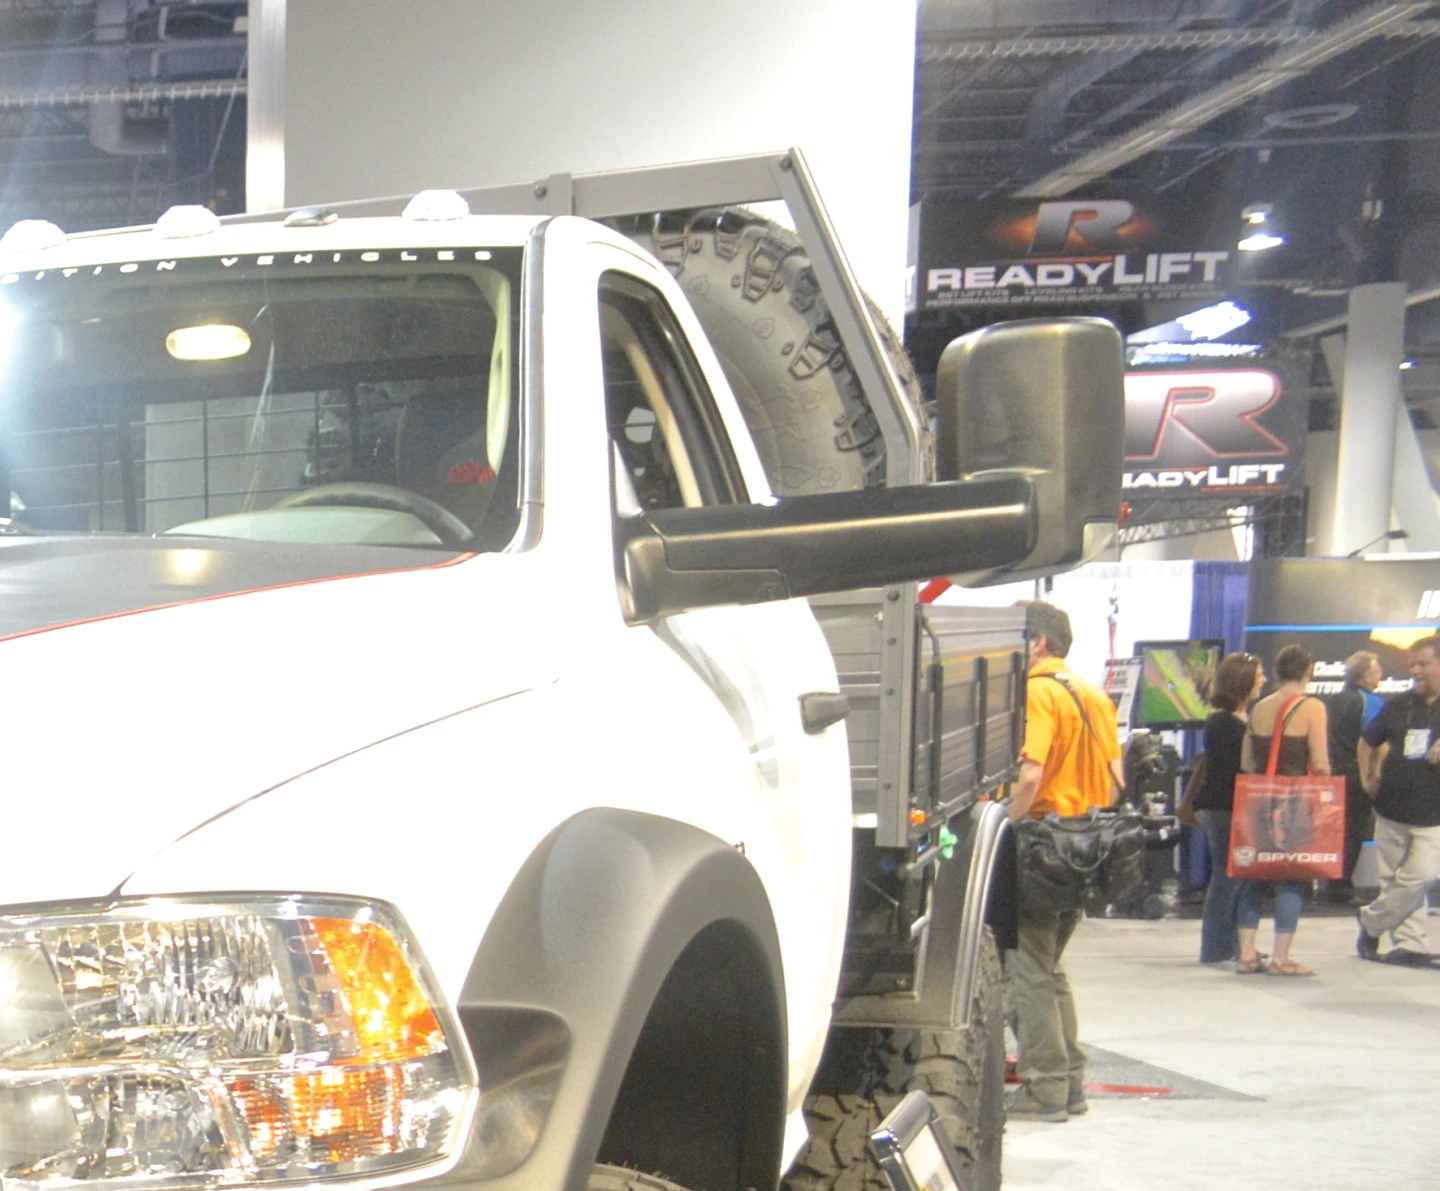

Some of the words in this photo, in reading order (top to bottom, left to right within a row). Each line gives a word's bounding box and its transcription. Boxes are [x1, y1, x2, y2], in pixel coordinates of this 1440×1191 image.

[221, 251, 492, 268] VEHICLES
[927, 251, 1229, 291] READYLIFT
[926, 296, 1009, 307] PERFORMANCE
[1034, 294, 1065, 303] ROAD
[1067, 291, 1137, 302] SUSPENSION
[961, 288, 982, 298] LIFT
[985, 287, 1009, 297] KITS
[1024, 284, 1078, 295] LEVELING
[1257, 851, 1338, 864] SPYDER
